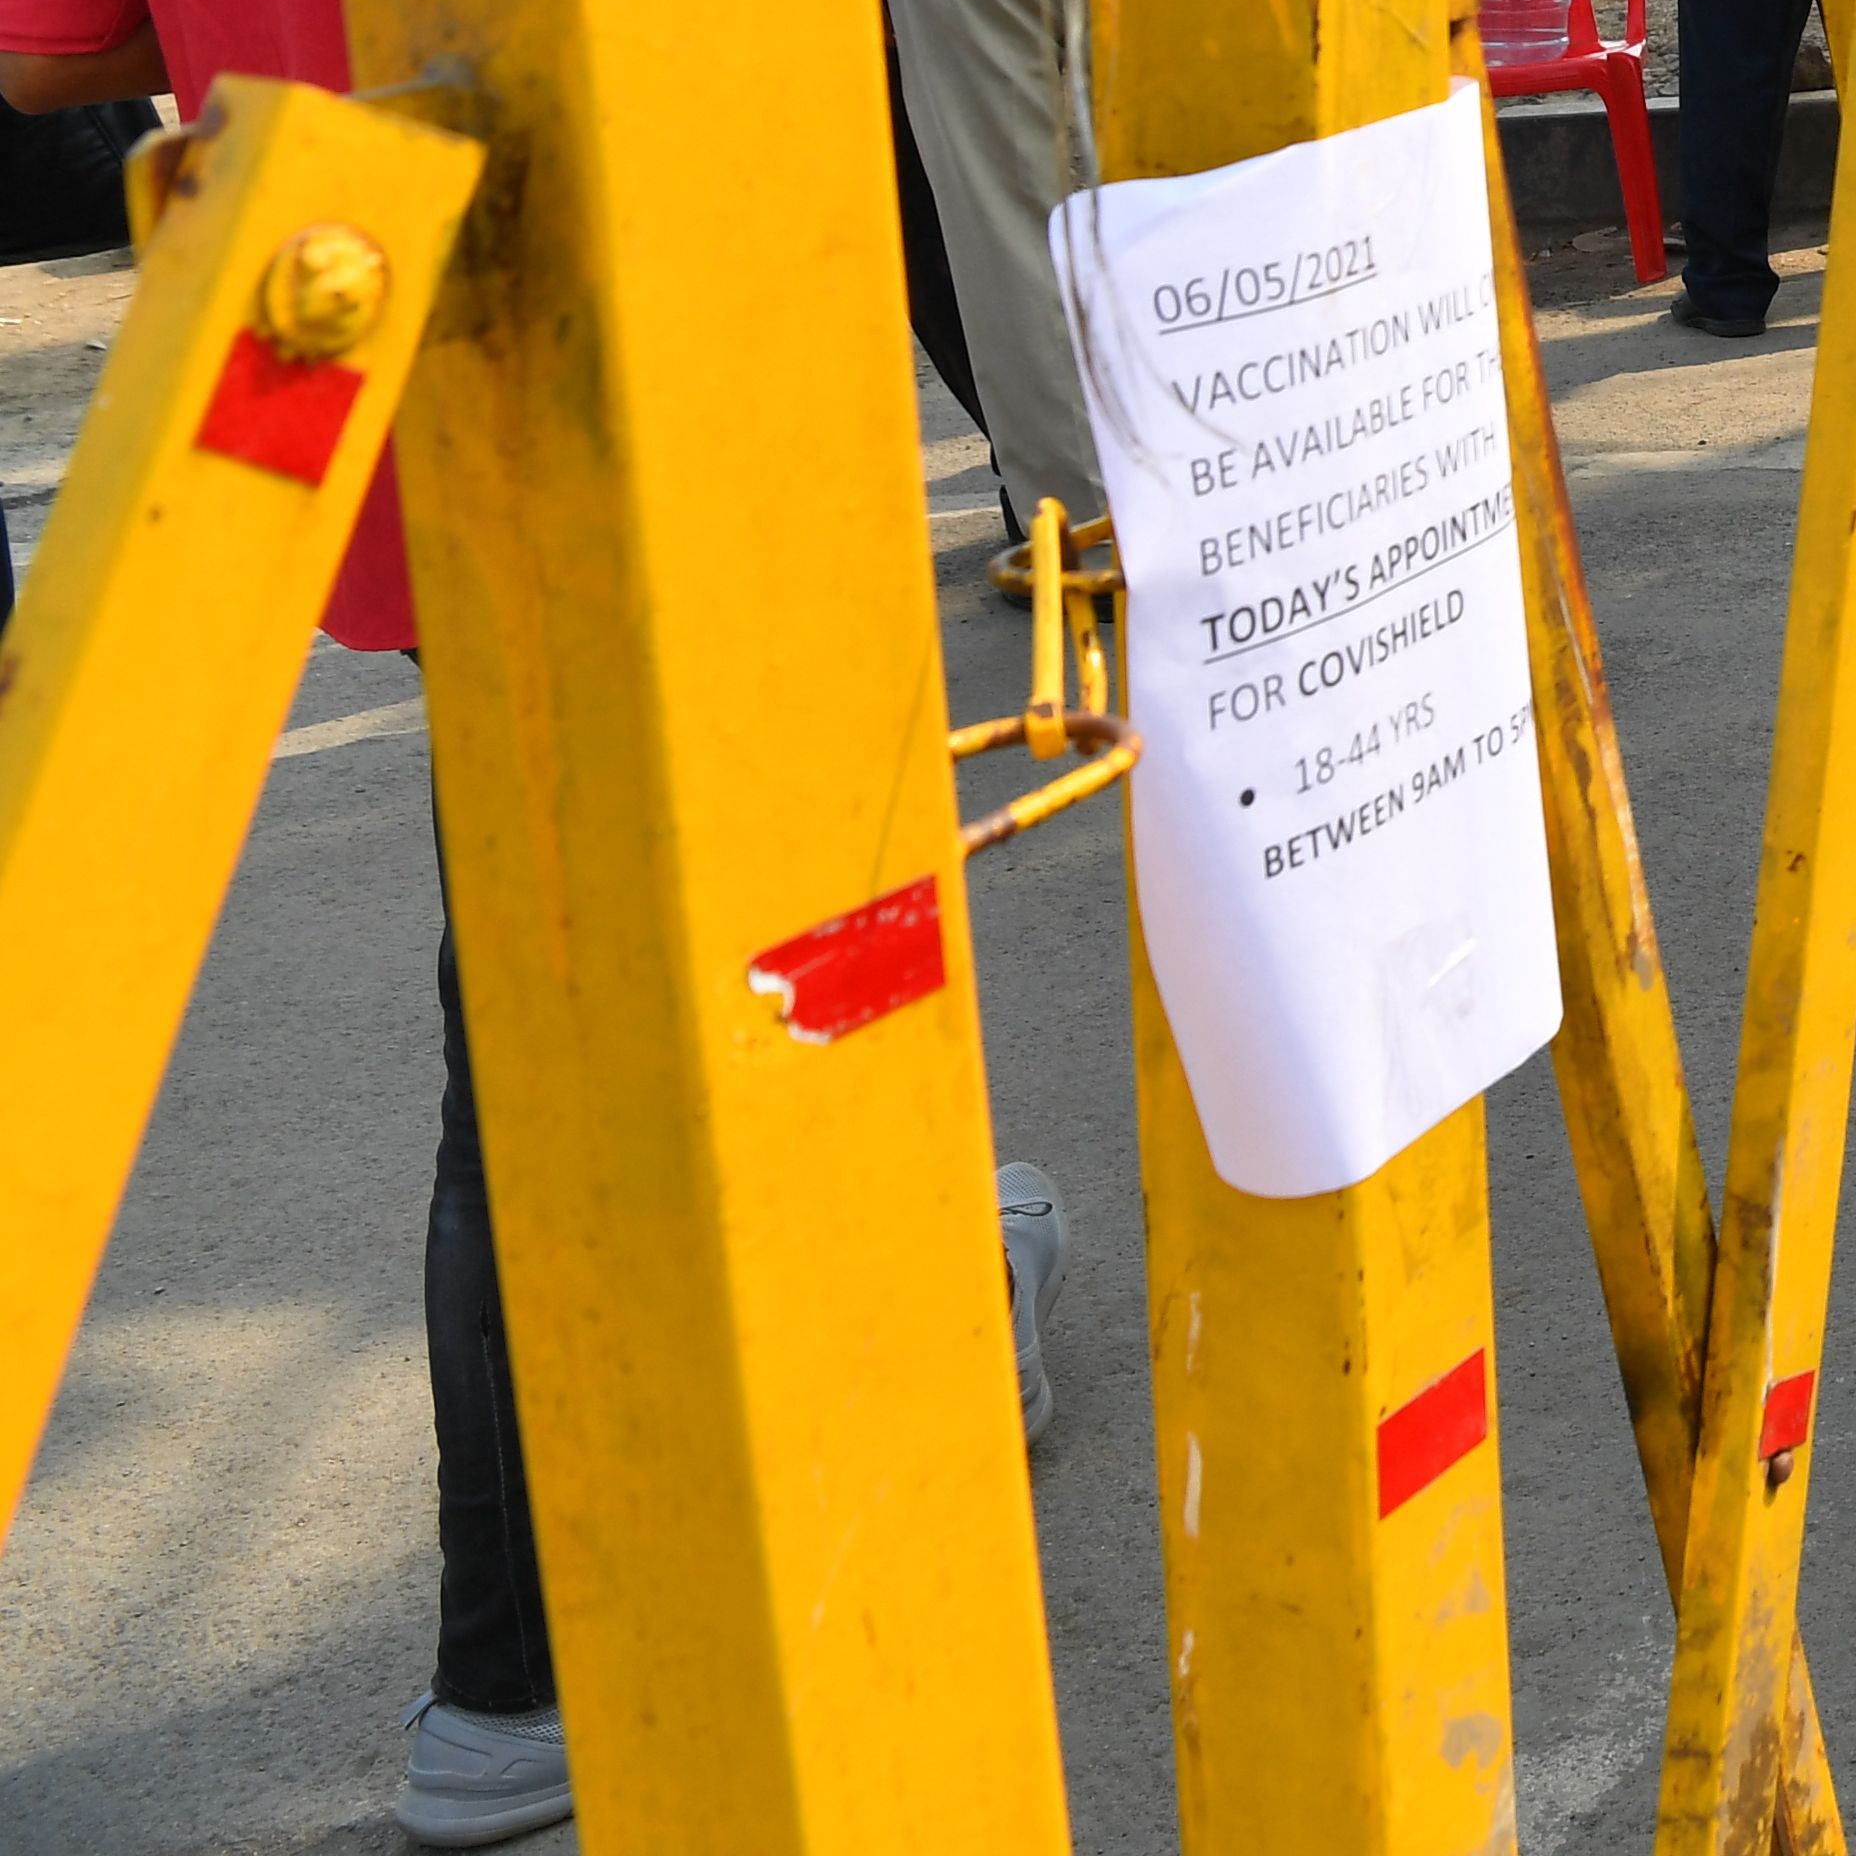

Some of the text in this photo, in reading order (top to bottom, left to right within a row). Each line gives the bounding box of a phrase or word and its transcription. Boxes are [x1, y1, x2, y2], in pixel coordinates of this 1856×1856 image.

[1153, 235, 1377, 324] 06/05/2021
[1172, 312, 1409, 415] VACCINATION
[1417, 285, 1475, 335] WILL
[1190, 448, 1238, 497] BE
[1250, 384, 1414, 480] AVAILABLE
[1422, 360, 1469, 411] FOR
[1200, 420, 1497, 577] BENEFICIARIES WITH
[1201, 563, 1361, 652] TODAY'S
[1208, 588, 1465, 731] FOR COVISHIELD
[1263, 783, 1405, 879] BETWEEN
[1411, 746, 1467, 804] 9AM
[1472, 725, 1504, 774] TO
[1294, 690, 1436, 795] 18-44 YRS
